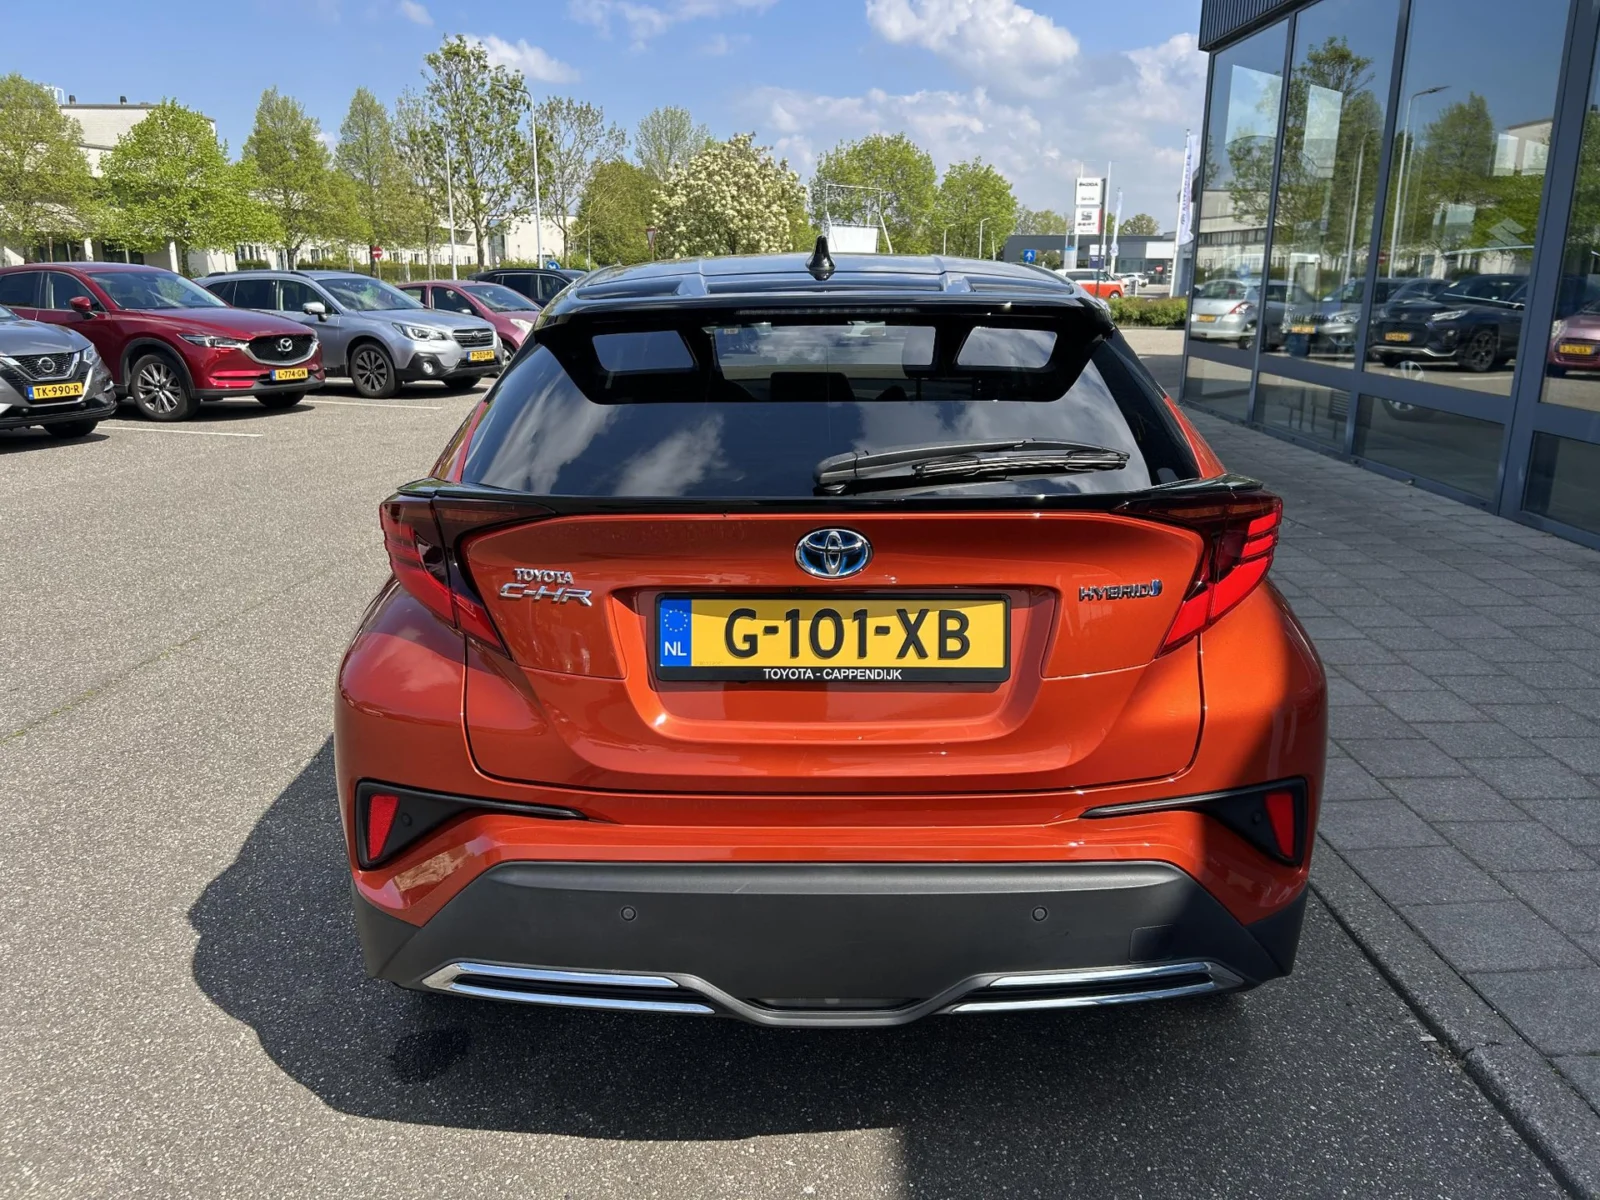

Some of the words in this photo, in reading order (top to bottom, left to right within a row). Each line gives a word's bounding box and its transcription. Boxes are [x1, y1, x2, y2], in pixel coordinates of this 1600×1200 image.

[278, 369, 306, 379] L-774-GN
[36, 384, 80, 397] TK-990-R
[514, 568, 574, 584] TOYOTA
[499, 583, 592, 607] C-HR
[1078, 583, 1151, 601] HYBRID
[724, 608, 971, 660] G-101-XB
[664, 641, 687, 656] NL
[763, 668, 814, 680] TOYOTA
[823, 668, 902, 680] CAPPENDIJK
